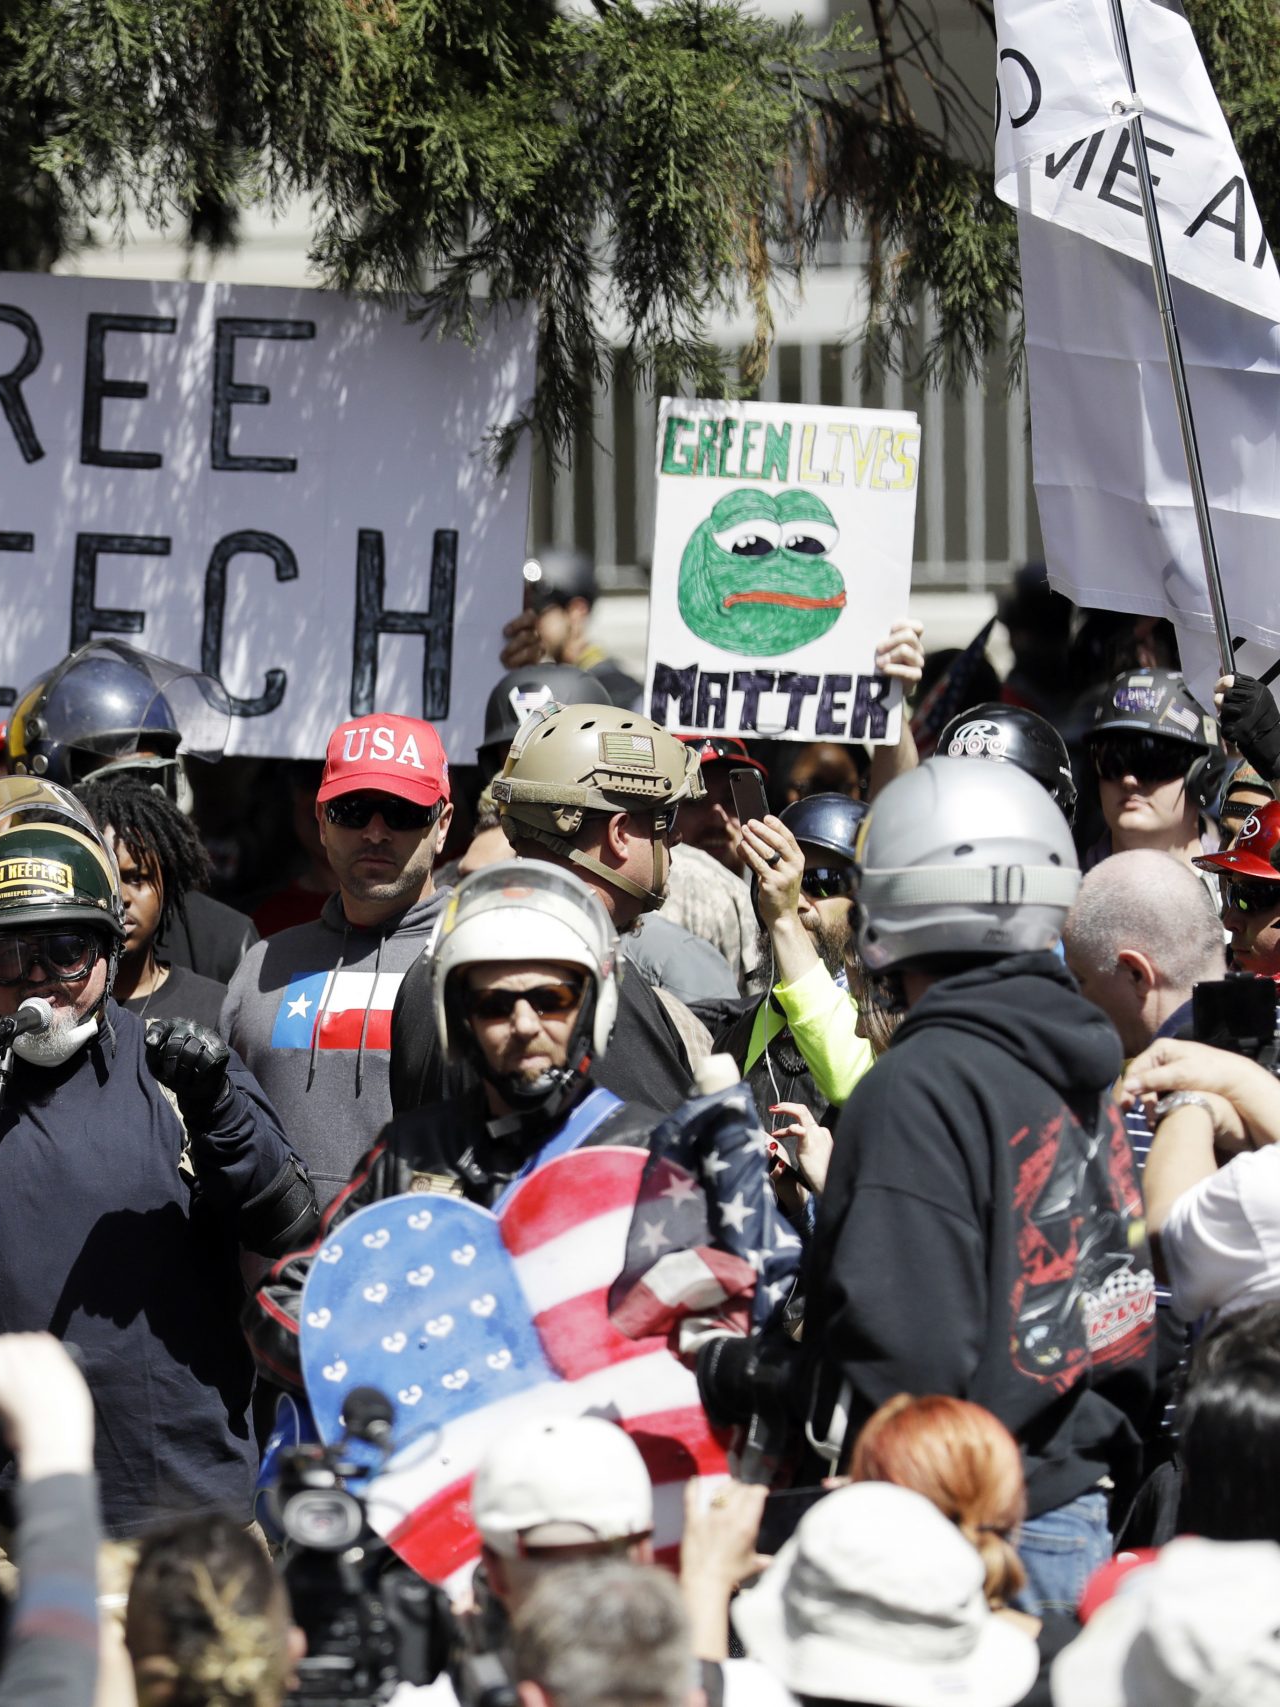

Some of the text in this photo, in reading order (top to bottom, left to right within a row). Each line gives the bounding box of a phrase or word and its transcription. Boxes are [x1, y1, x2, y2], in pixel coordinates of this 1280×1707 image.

[660, 416, 920, 491] GREEN LIVES
[650, 660, 892, 740] MATTER
[342, 726, 426, 770] USA
[8, 863, 66, 884] KEEPERS
